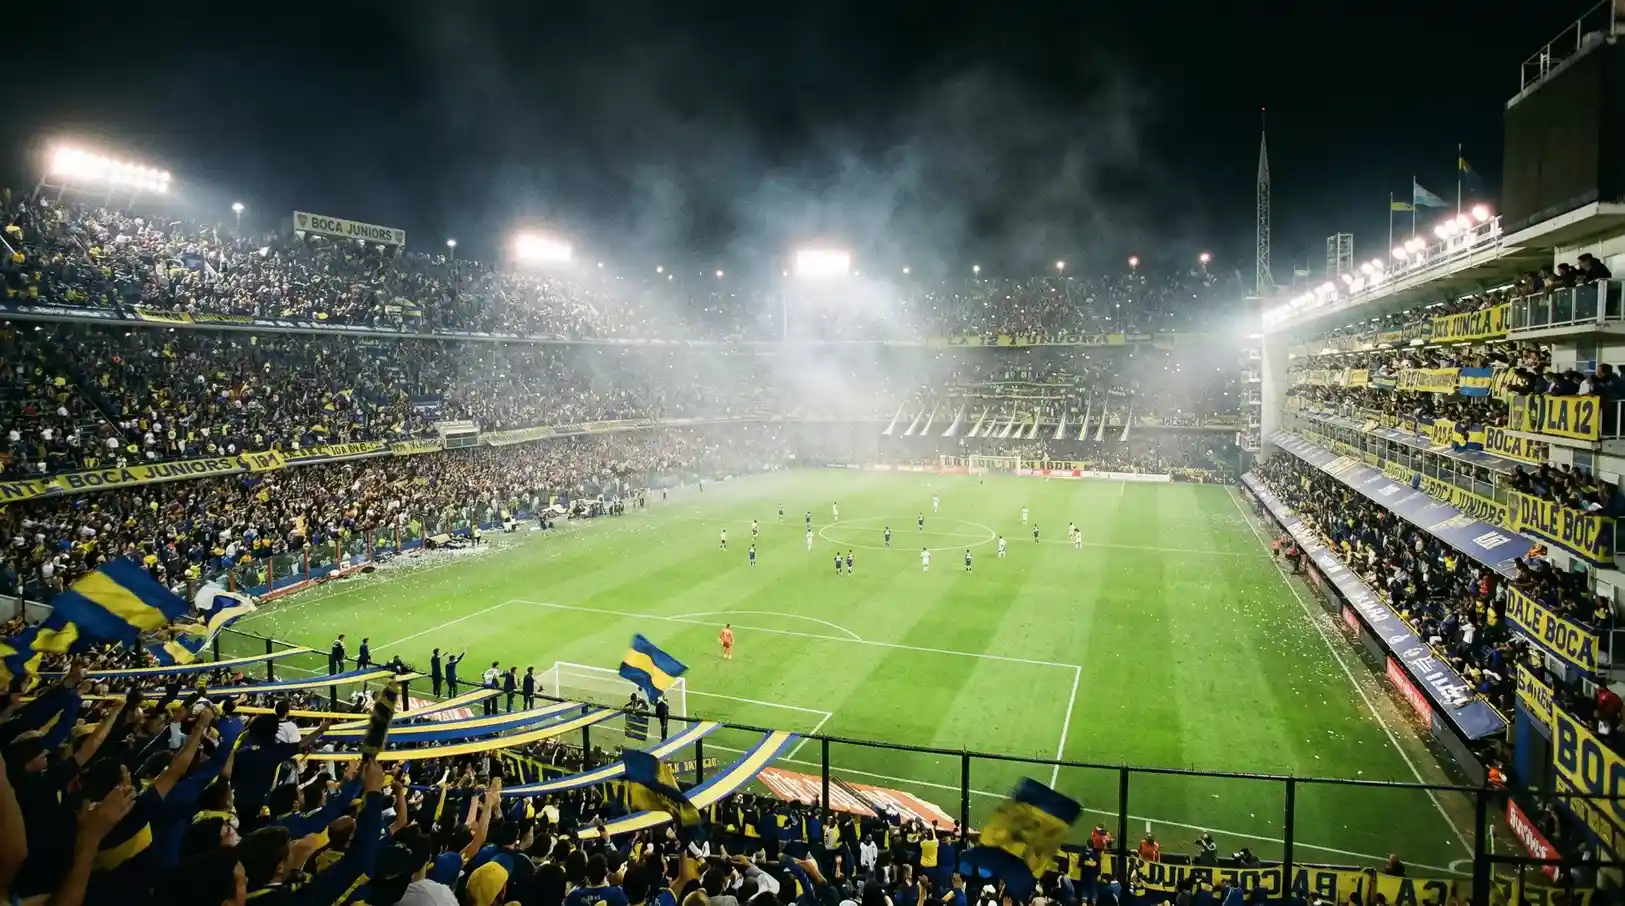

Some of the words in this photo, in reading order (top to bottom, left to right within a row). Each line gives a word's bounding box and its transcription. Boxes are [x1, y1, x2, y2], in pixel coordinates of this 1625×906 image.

[311, 217, 343, 232] BOCA
[346, 223, 392, 240] JUNIORS
[1547, 399, 1568, 431] LA
[1573, 400, 1594, 433] 12
[1486, 427, 1521, 458] BOCA
[65, 469, 140, 488] BOCA
[144, 457, 233, 479] JUNIORS
[1458, 491, 1506, 524] JUNIORS
[1521, 496, 1558, 537] DALE
[1562, 508, 1615, 556] BOCA
[1507, 589, 1542, 635] DALE
[1544, 615, 1596, 669] BOCA
